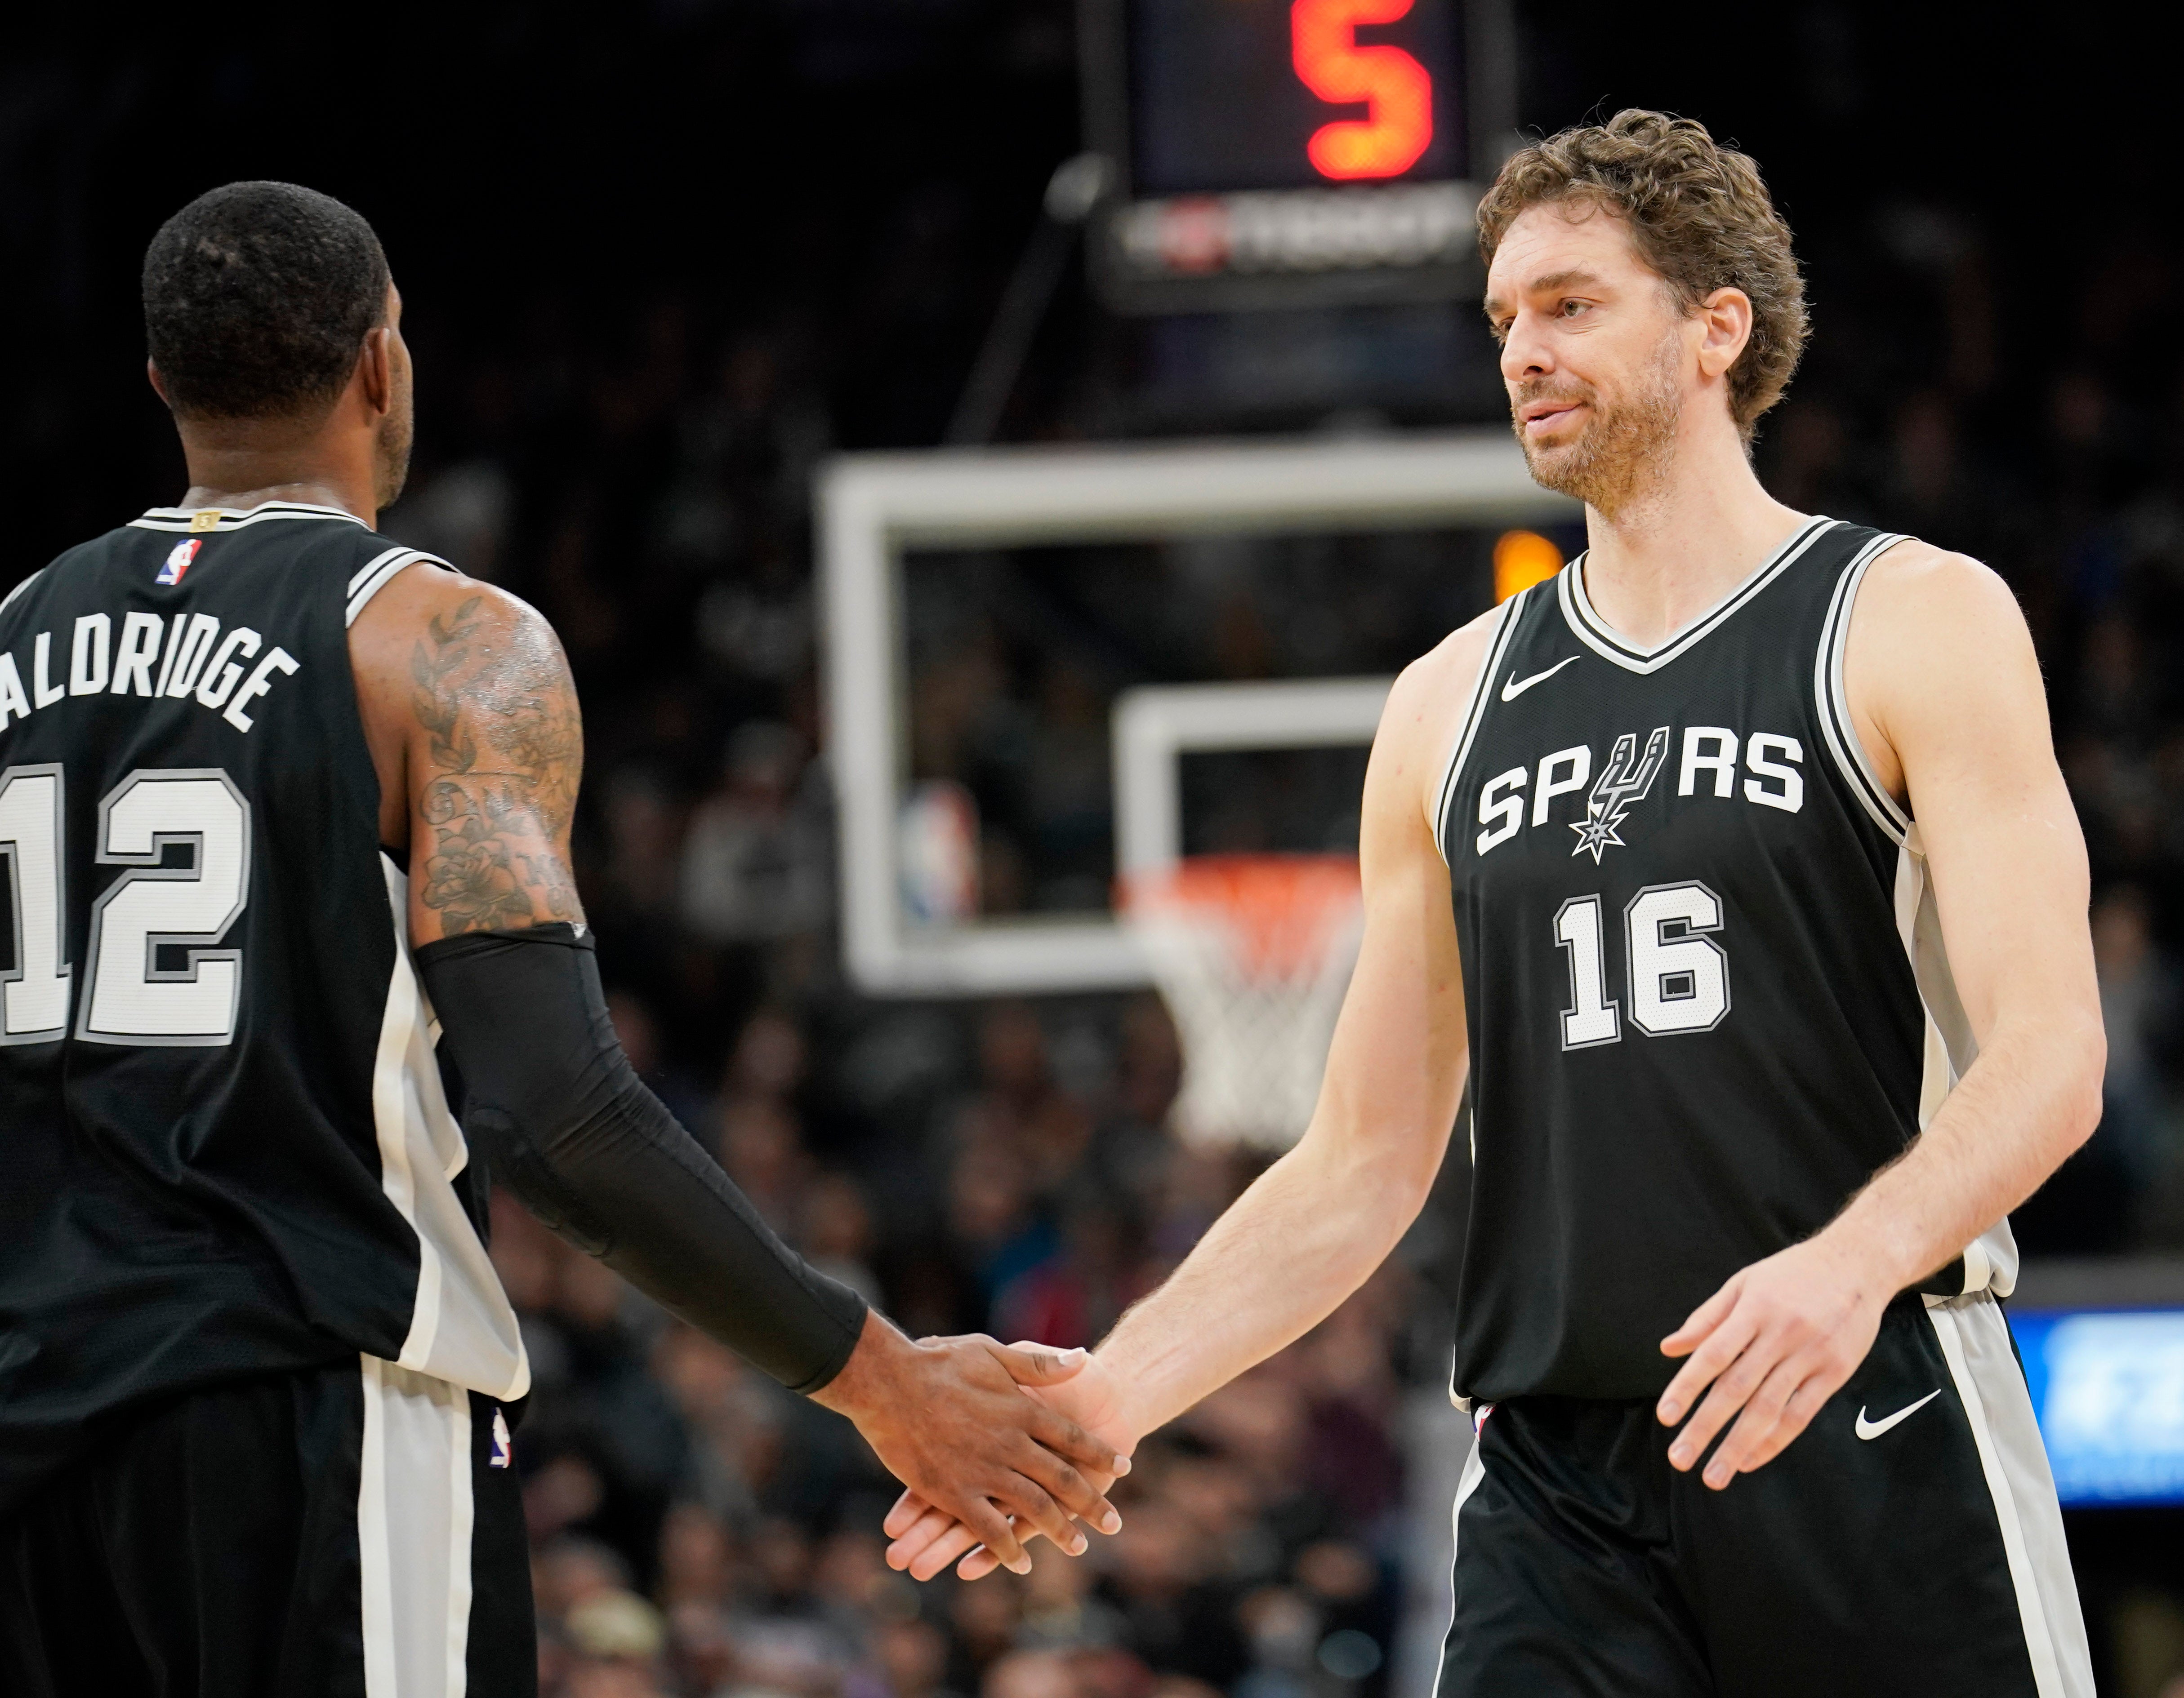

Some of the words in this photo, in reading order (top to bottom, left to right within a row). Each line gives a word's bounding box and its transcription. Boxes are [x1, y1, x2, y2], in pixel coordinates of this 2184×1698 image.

[1291, 0, 1433, 180] 5
[0, 611, 300, 733] ALDRIDGE
[1476, 726, 1804, 865] SPURS
[0, 763, 252, 1047] 12
[1553, 880, 1731, 1052] 16
